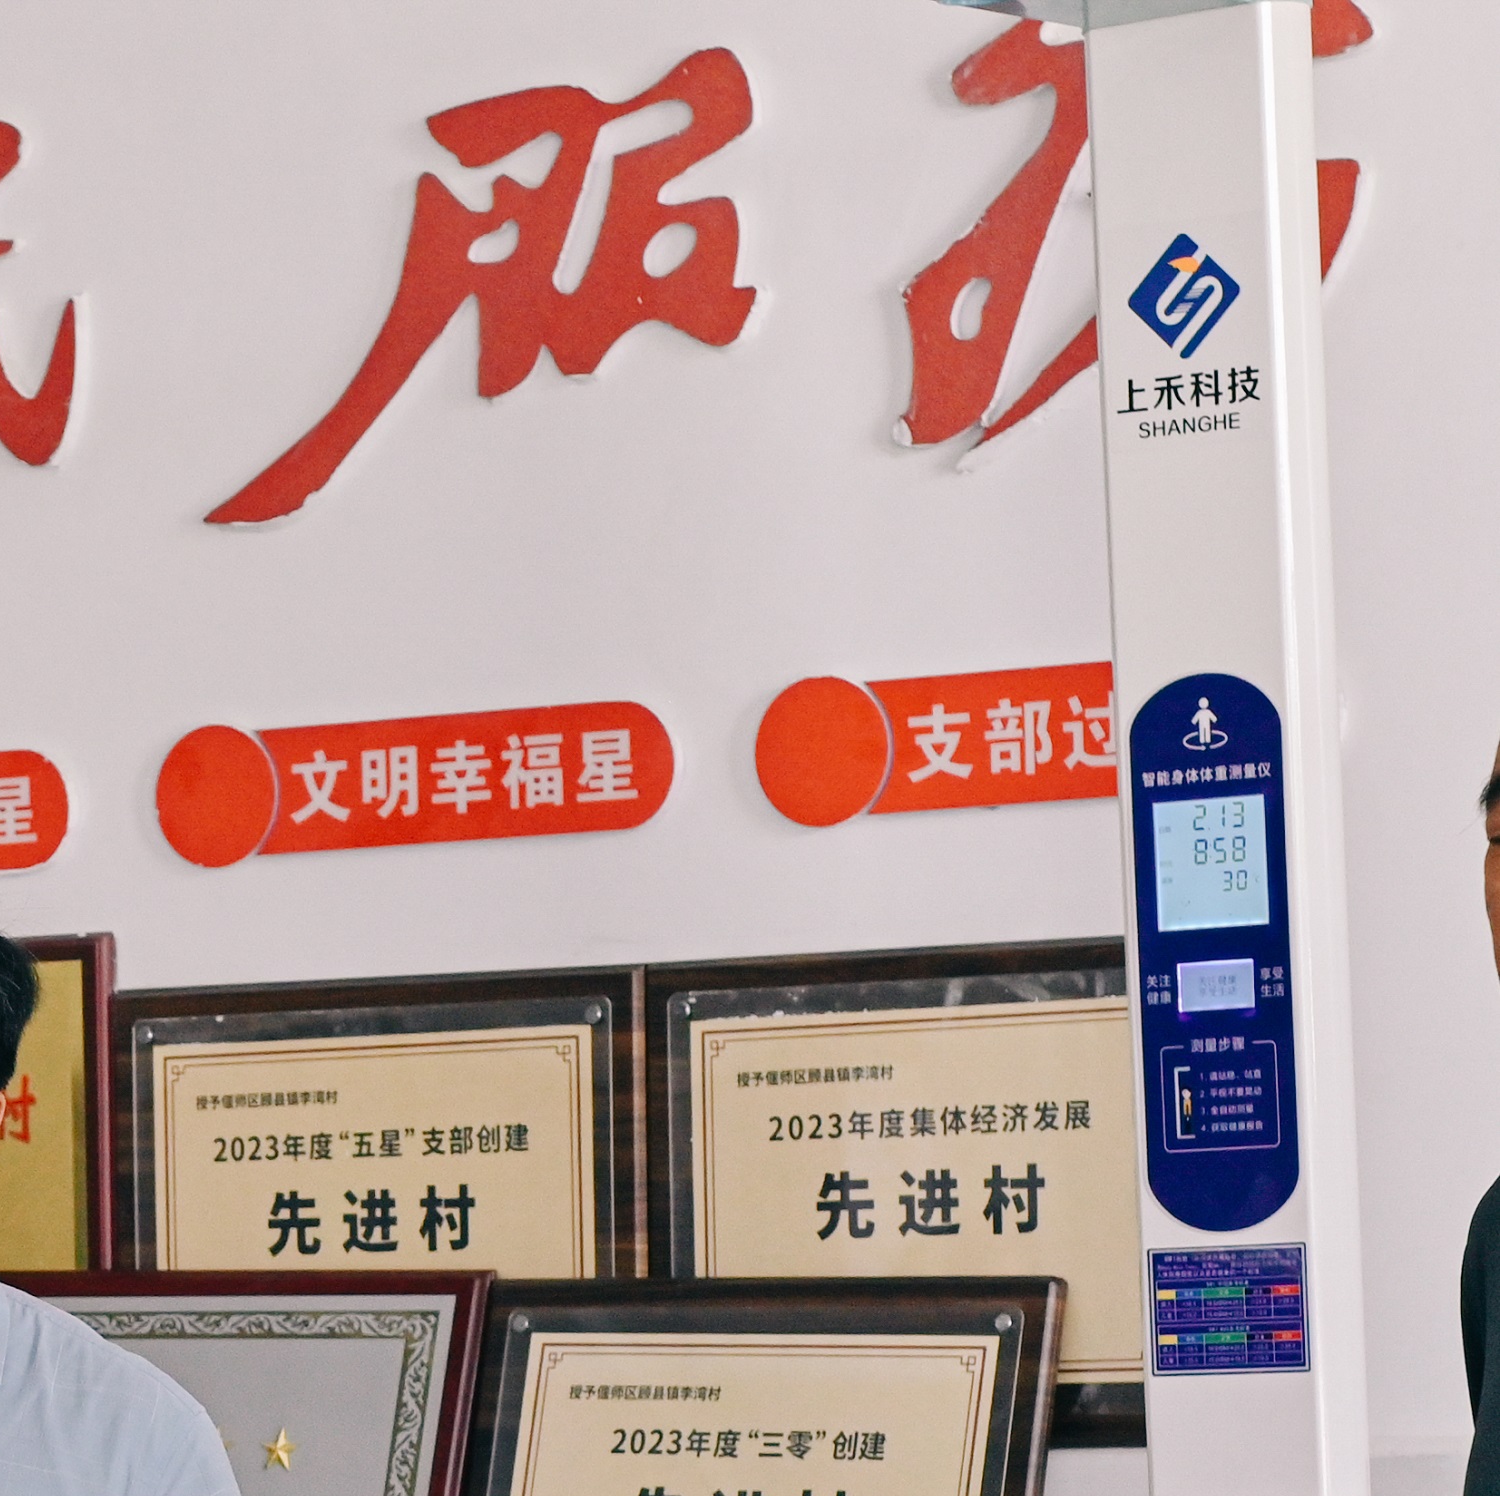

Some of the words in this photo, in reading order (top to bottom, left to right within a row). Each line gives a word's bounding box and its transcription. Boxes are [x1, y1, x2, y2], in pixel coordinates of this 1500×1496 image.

[1117, 365, 1261, 414] 上禾科技
[1138, 412, 1241, 439] SHANGHE
[288, 727, 641, 826] 文明幸福星
[213, 1123, 529, 1162] 2023年度“五星”支部创建
[768, 1100, 1091, 1142] 2023年度集体经济发展
[268, 1184, 476, 1257] 先进村
[816, 1162, 1046, 1240] 先进村
[610, 1428, 886, 1461] 2023年度“三零”创建
